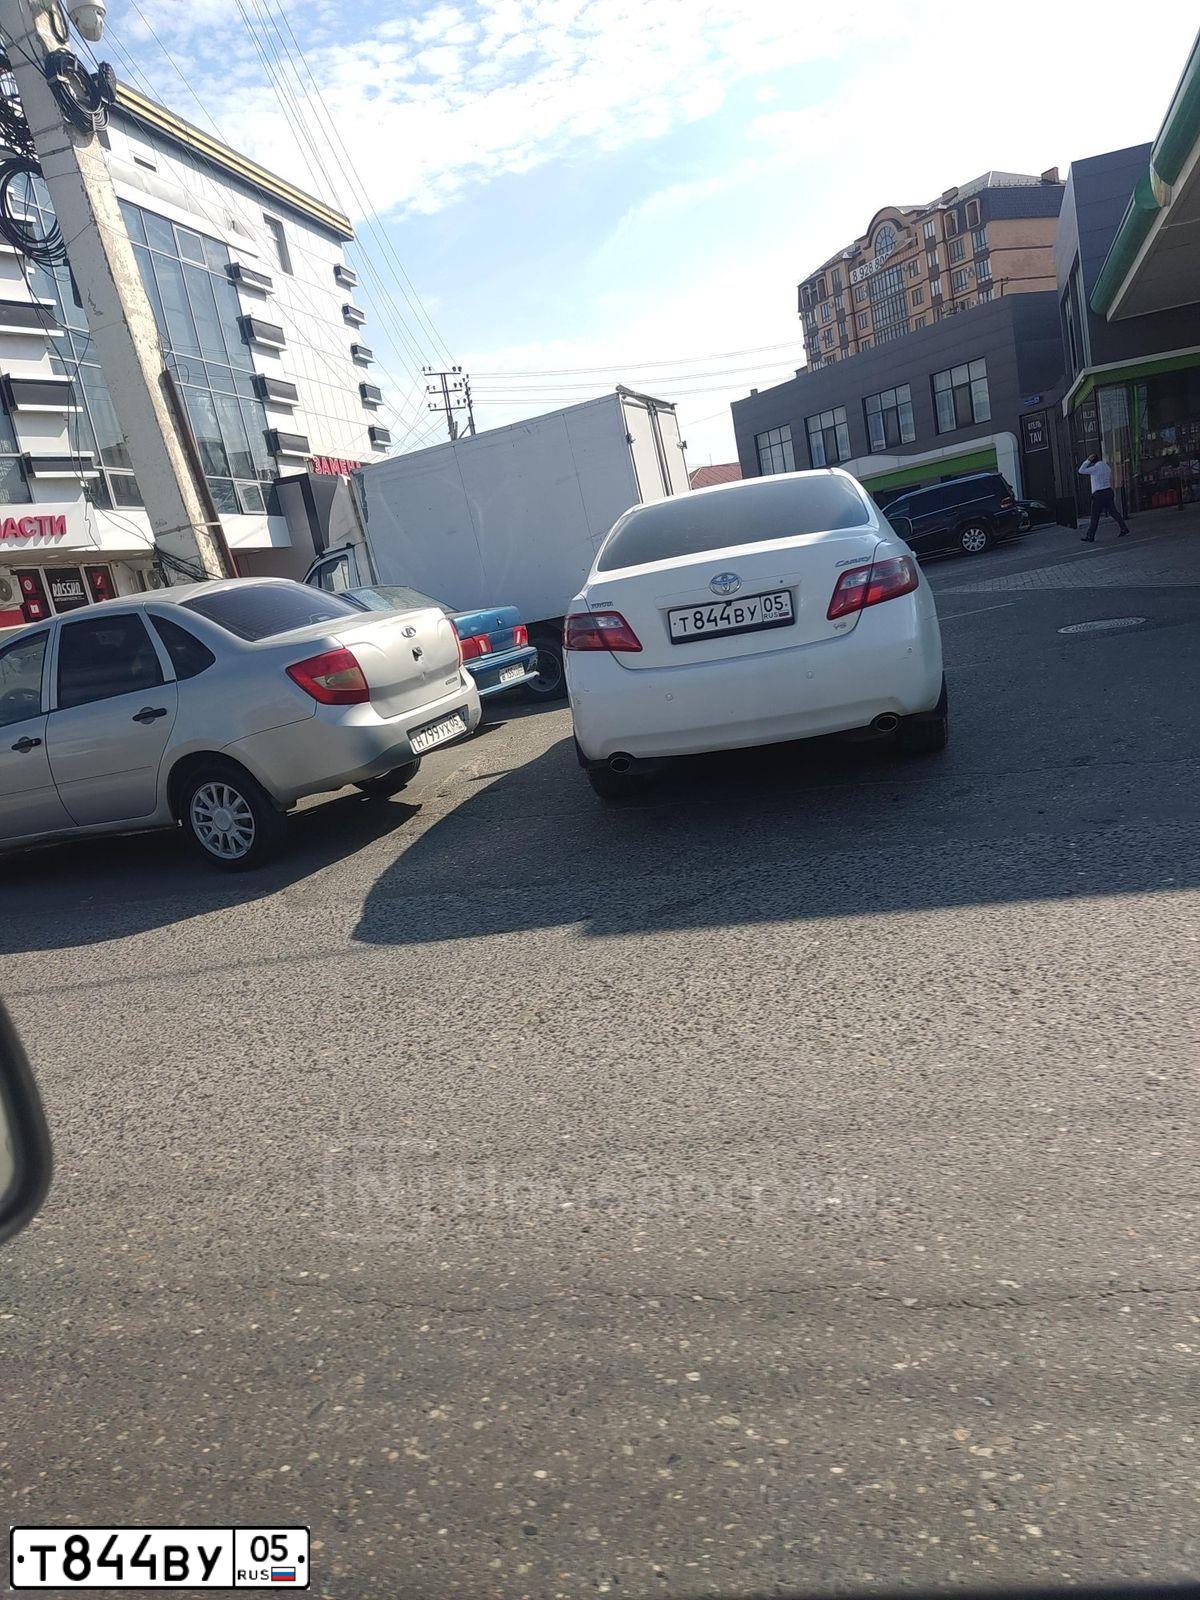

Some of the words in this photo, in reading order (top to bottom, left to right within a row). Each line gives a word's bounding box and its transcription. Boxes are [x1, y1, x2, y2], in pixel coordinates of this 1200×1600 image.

[0, 515, 67, 539] АСТИ
[763, 595, 784, 613] 05
[763, 611, 779, 620] RUS
